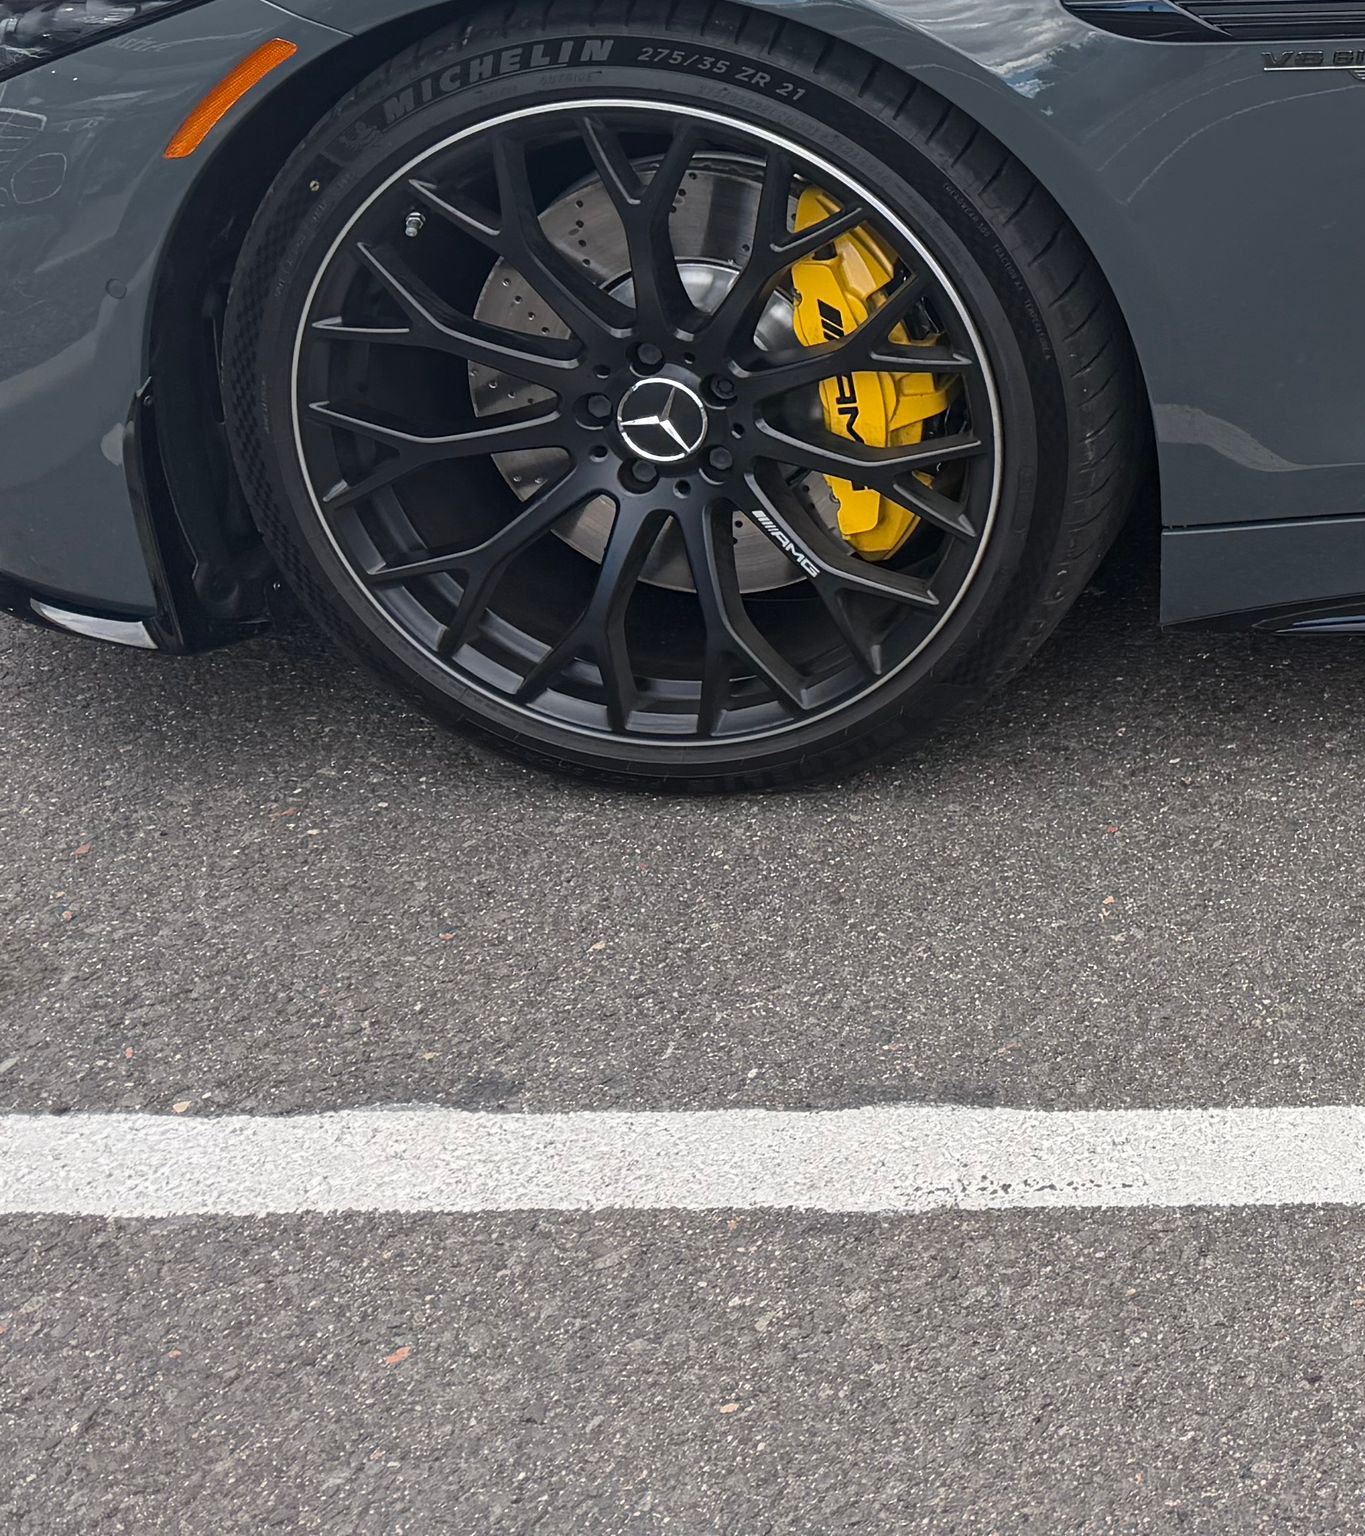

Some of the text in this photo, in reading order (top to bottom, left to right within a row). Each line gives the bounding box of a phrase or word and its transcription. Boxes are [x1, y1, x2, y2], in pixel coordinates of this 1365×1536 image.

[383, 39, 614, 124] MICHELIN
[637, 47, 731, 74] 275/35
[734, 66, 771, 88] ZR
[776, 82, 806, 101] 21
[1261, 51, 1323, 65] V8
[770, 531, 820, 578] AMG
